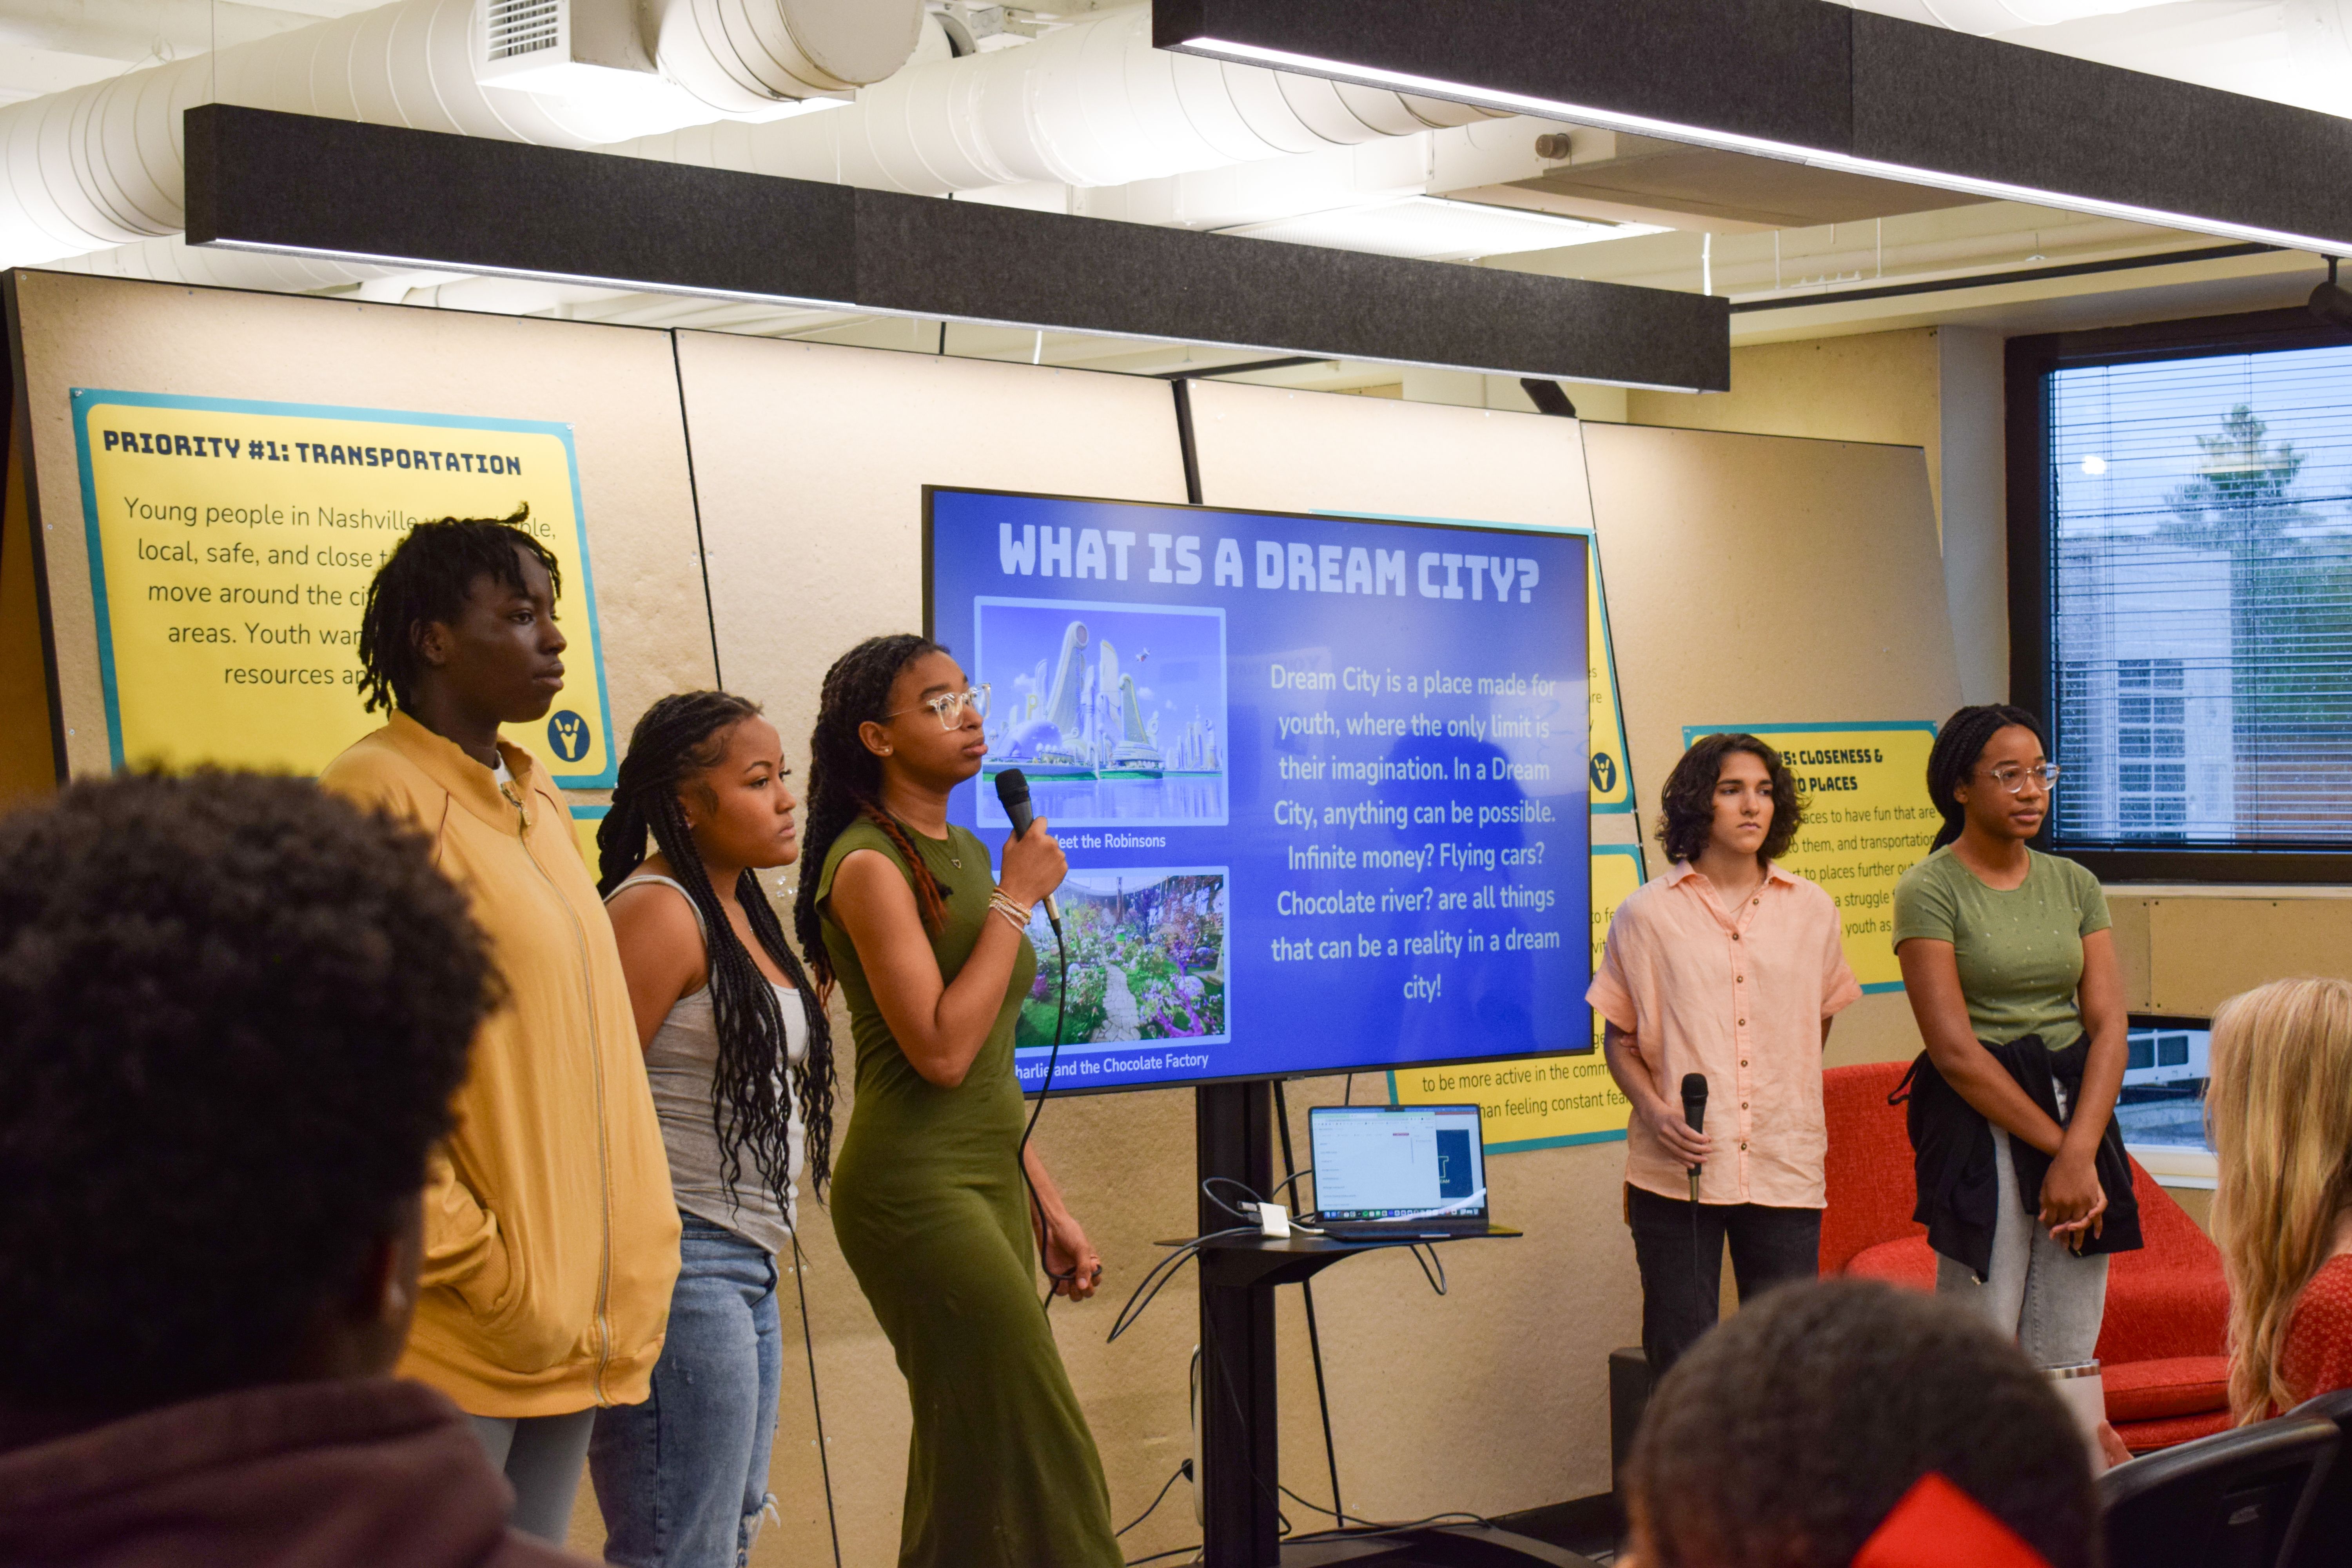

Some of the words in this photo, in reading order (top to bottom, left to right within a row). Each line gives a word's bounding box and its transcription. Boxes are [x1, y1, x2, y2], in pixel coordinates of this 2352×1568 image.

[103, 430, 240, 459] PRIORITY
[249, 439, 290, 462] #1:
[295, 443, 522, 475] TRANSPORTATION
[124, 496, 197, 527] Young
[206, 503, 284, 528] people
[292, 505, 309, 526] in
[319, 506, 417, 532] Nashville
[139, 538, 198, 564] local,
[207, 542, 259, 566] safe,
[268, 545, 309, 565] and
[317, 546, 372, 567] close
[380, 550, 388, 566] t
[1000, 523, 1136, 581] WHAT
[1148, 533, 1202, 585] IS
[1215, 538, 1243, 587] A
[1256, 541, 1406, 597] DREAM
[1418, 552, 1539, 603] CITY?
[149, 585, 211, 603] move
[220, 584, 299, 604] around
[307, 584, 342, 605] the
[169, 627, 237, 643] areas.
[245, 622, 310, 645] Youth
[319, 629, 363, 645] wan
[225, 667, 334, 684] resources
[342, 668, 367, 685] an
[1271, 664, 1336, 691] Dream
[1343, 667, 1381, 697] City
[1387, 668, 1401, 693] is
[1407, 676, 1418, 693] a
[1424, 670, 1472, 699] place
[1479, 673, 1526, 696] made
[1531, 673, 1556, 697] for
[1279, 711, 1340, 740] youth,
[1347, 711, 1406, 737] where
[1412, 712, 1442, 737] the
[1447, 714, 1486, 742] only
[1492, 715, 1532, 739] limit
[1536, 715, 1550, 739] is
[1279, 755, 1326, 780] their
[1332, 755, 1448, 786] imagination.
[1454, 756, 1470, 780] In
[1476, 763, 1486, 780] a
[1492, 757, 1550, 781] Dream
[1799, 748, 1872, 765] CLOSENESS
[1874, 748, 1883, 763] &
[1797, 777, 1806, 793] O
[1809, 776, 1858, 792] PLACES
[1274, 800, 1318, 831] City,
[1324, 800, 1408, 830] anything
[1414, 805, 1445, 825] can
[1451, 800, 1473, 824] be
[1479, 800, 1556, 828] possible.
[1803, 812, 1828, 824] aces
[1831, 809, 1842, 823] to
[1845, 808, 1871, 822] have
[1874, 806, 1892, 820] fun
[1894, 806, 1916, 820] that
[1919, 807, 1936, 819] are
[1081, 834, 1101, 848] the
[1105, 833, 1166, 848] Robinsons
[1802, 838, 1834, 853] them,
[1838, 835, 1858, 851] and
[1289, 844, 1356, 870] Infinite
[1363, 843, 1435, 873] money?
[1440, 842, 1495, 871] Flying
[1501, 841, 1545, 866] cars?
[1805, 867, 1817, 881] to
[1820, 864, 1855, 883] places
[1858, 862, 1895, 878] further
[1278, 889, 1376, 916] Chocolate
[1381, 887, 1433, 913] river?
[1439, 892, 1467, 911] are
[1473, 885, 1495, 910] all
[1500, 884, 1555, 912] things
[1835, 896, 1841, 907] a
[1844, 890, 1890, 909] struggle
[1845, 918, 1877, 937] youth
[1880, 920, 1891, 932] as
[1271, 936, 1313, 962] that
[1319, 940, 1352, 960] can
[1358, 934, 1382, 958] be
[1388, 938, 1398, 956] a
[1404, 930, 1463, 958] reality
[1468, 929, 1484, 953] in
[1490, 934, 1500, 951] a
[1505, 927, 1560, 951] dream
[1404, 973, 1442, 1003] city!
[1015, 1063, 1050, 1079] harlie
[1054, 1061, 1077, 1076] and
[1080, 1060, 1100, 1074] the
[1103, 1056, 1163, 1073] Chocolate
[1165, 1053, 1209, 1069] Factory
[1423, 1076, 1436, 1092] to
[1439, 1074, 1455, 1091] be
[1459, 1073, 1492, 1089] more
[1495, 1067, 1532, 1085] active
[1535, 1065, 1547, 1081] in
[1550, 1064, 1569, 1080] the
[1479, 1103, 1501, 1119] han
[1505, 1099, 1548, 1116] feeling
[1552, 1091, 1604, 1111] constant
